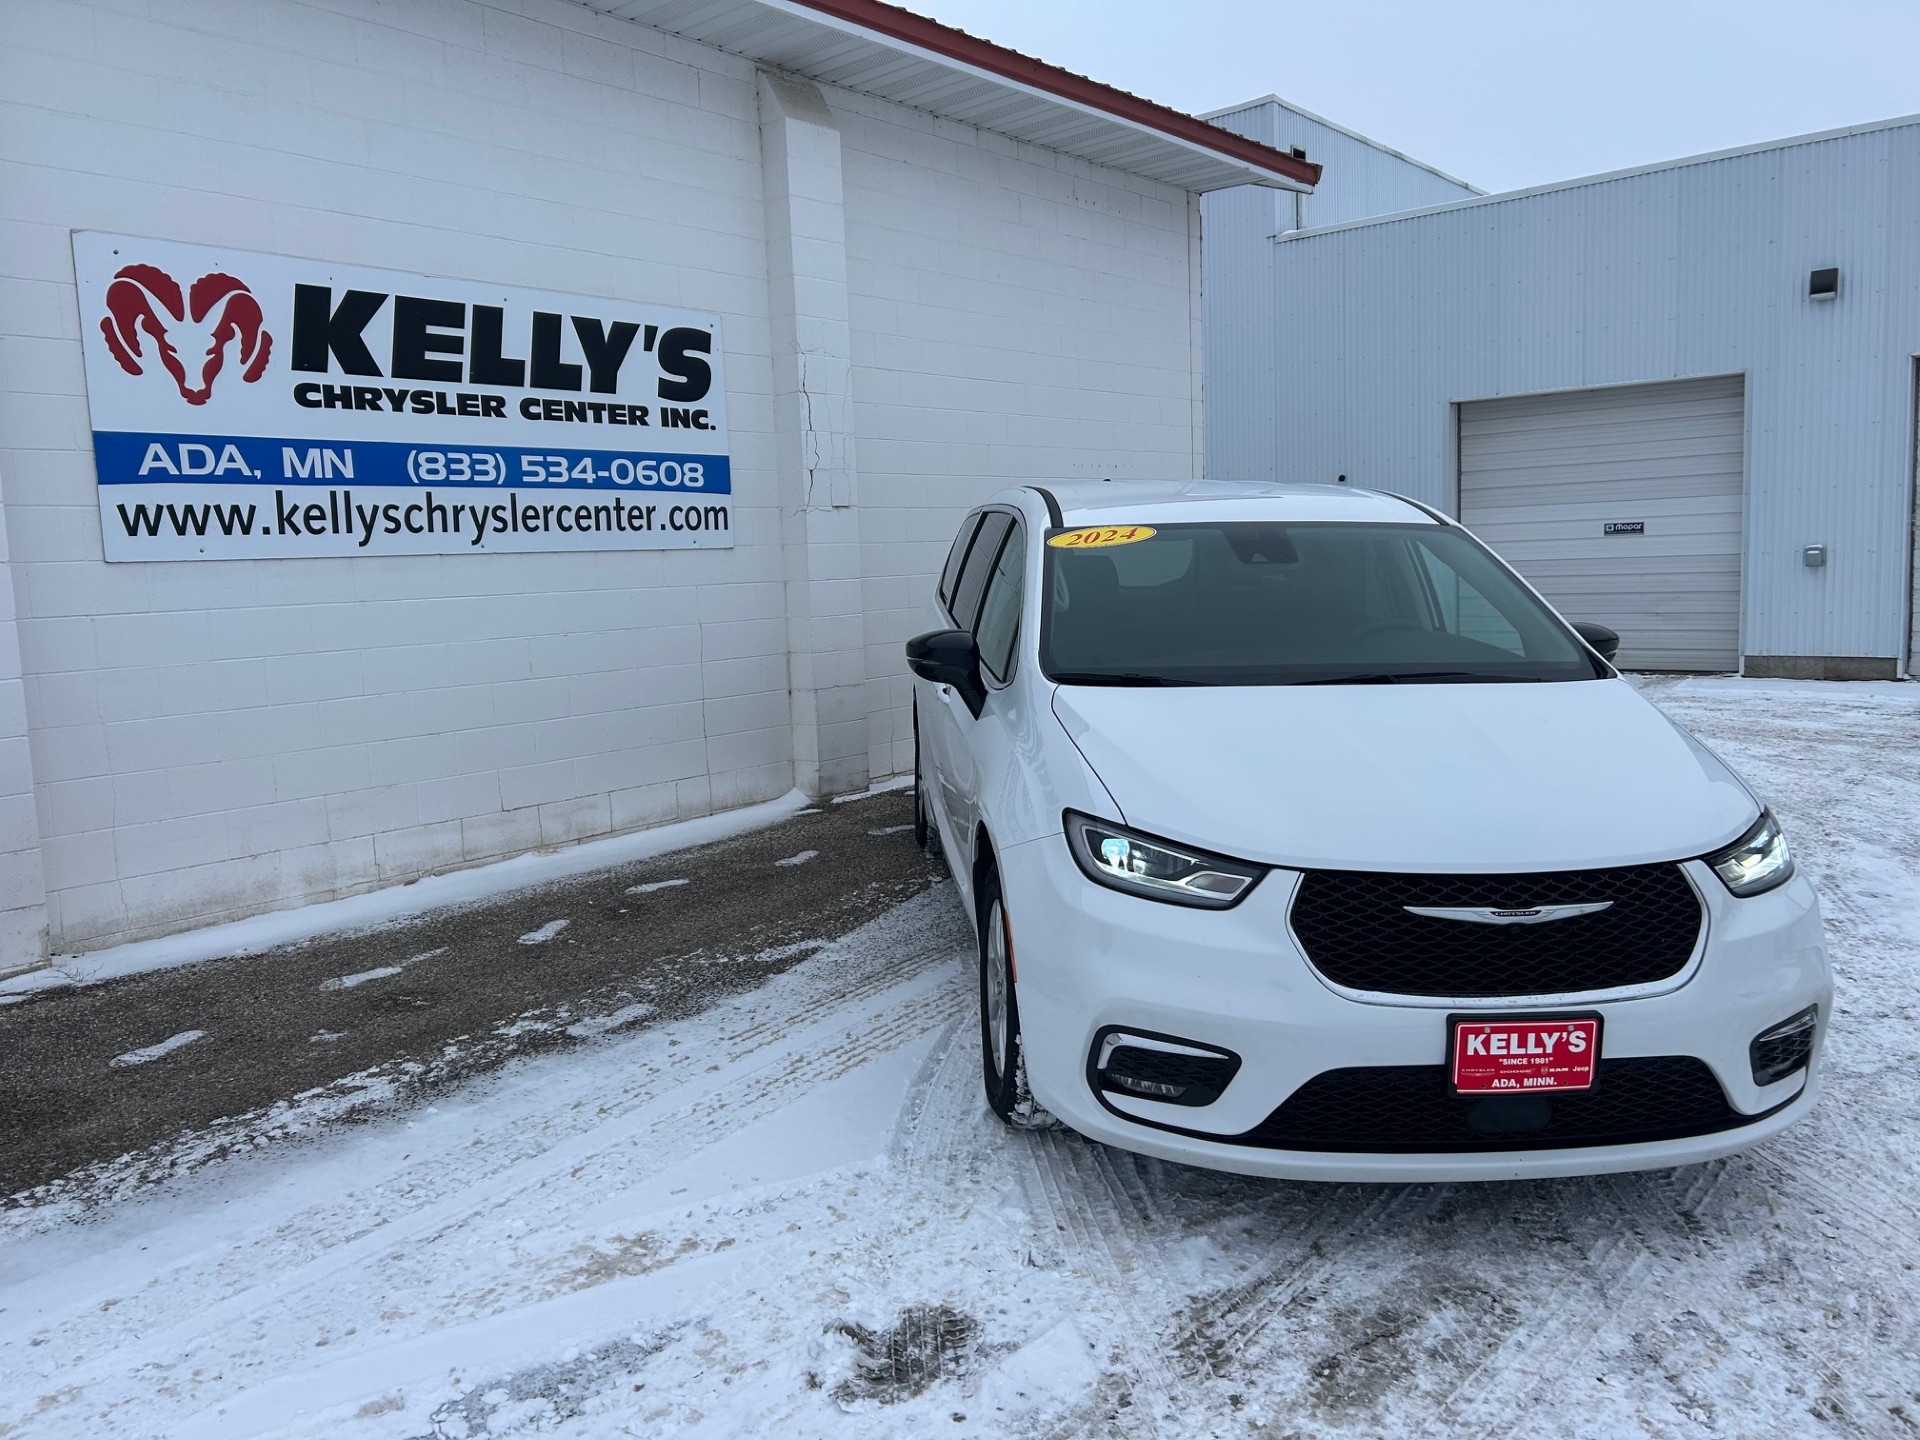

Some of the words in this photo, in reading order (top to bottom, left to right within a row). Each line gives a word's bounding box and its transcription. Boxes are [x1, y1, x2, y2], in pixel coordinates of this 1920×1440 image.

[291, 283, 712, 402] KELLY'S
[293, 382, 508, 418] CHRYSLER
[519, 397, 650, 426] CENTER
[660, 406, 717, 431] INC.
[138, 443, 262, 480] ADA,
[282, 447, 354, 479] MN
[406, 450, 507, 485] (833)
[520, 454, 704, 488] 534-0608
[116, 489, 729, 547] www.kellyschryslercenter.com
[1065, 527, 1138, 546] 2024
[1466, 1030, 1587, 1056] KELLY'S
[1491, 1078, 1520, 1088] ADA,
[1523, 1077, 1557, 1087] MINN.
